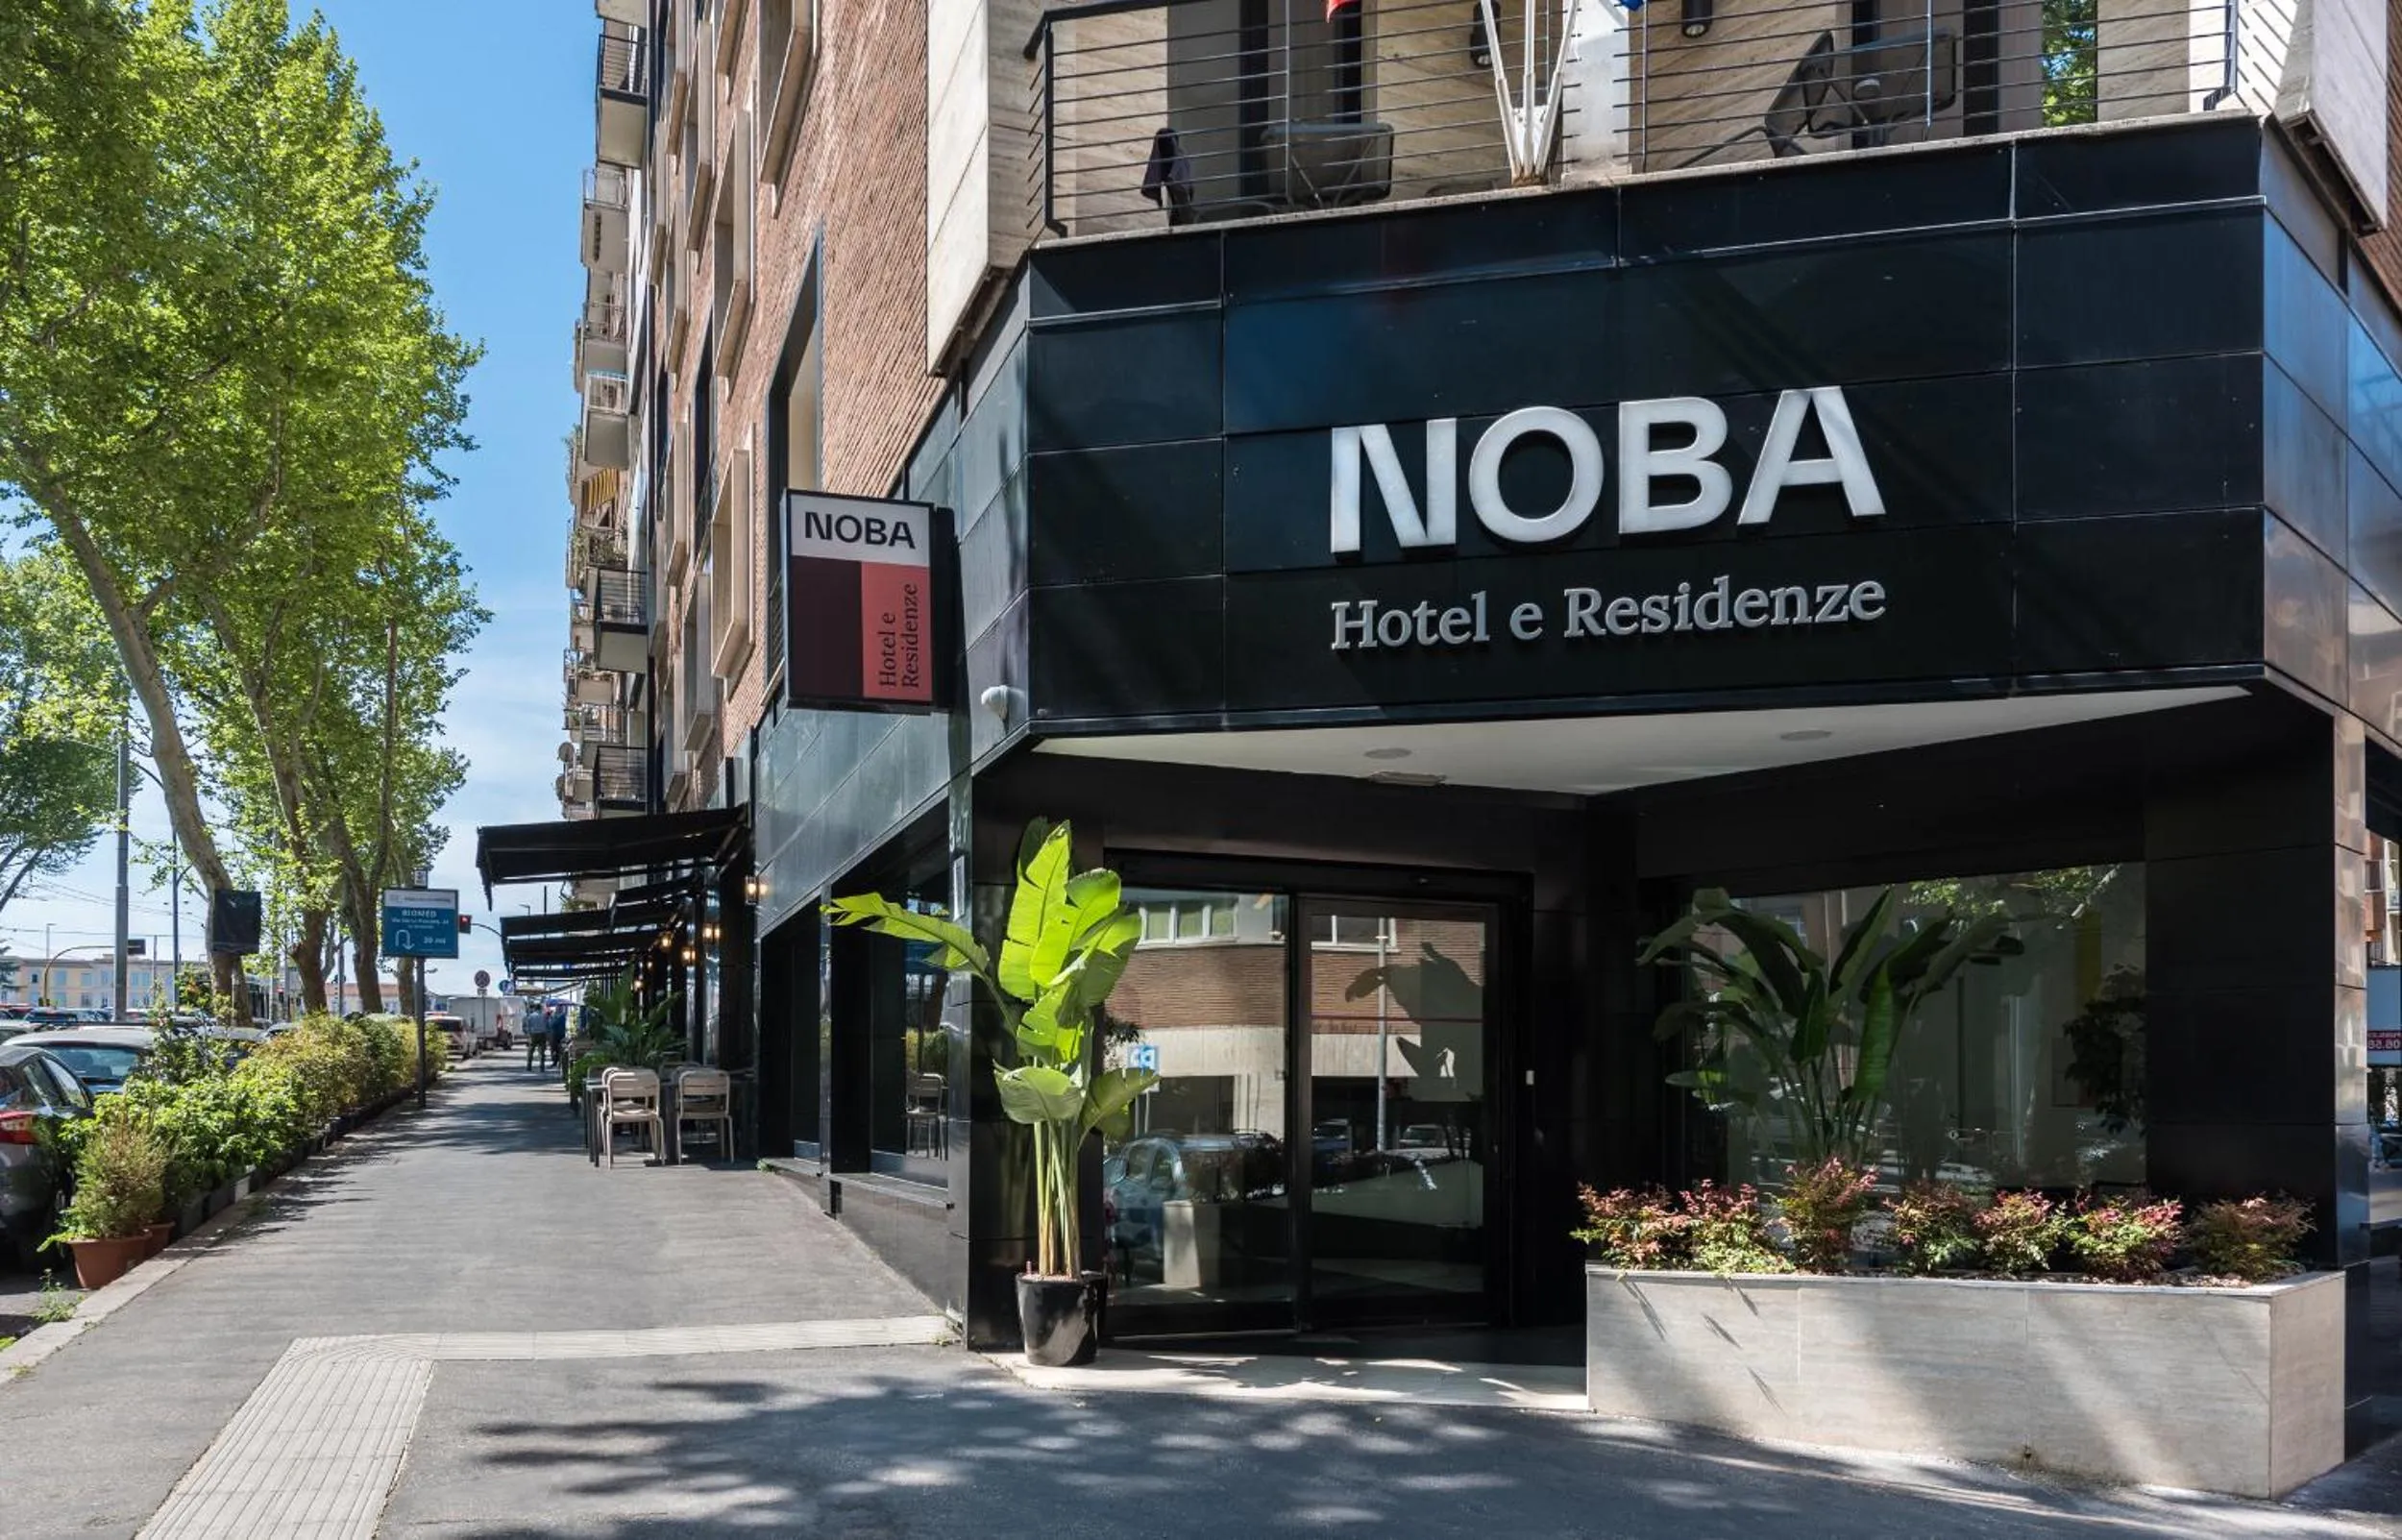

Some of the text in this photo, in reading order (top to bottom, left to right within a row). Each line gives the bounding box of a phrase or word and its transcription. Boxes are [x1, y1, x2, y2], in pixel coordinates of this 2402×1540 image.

[1330, 385, 1886, 554] NOBA
[804, 511, 917, 550] NOBA
[877, 612, 897, 687] Hotel e
[901, 583, 919, 688] Residenze
[1331, 574, 1886, 650] Hotel e Residenze
